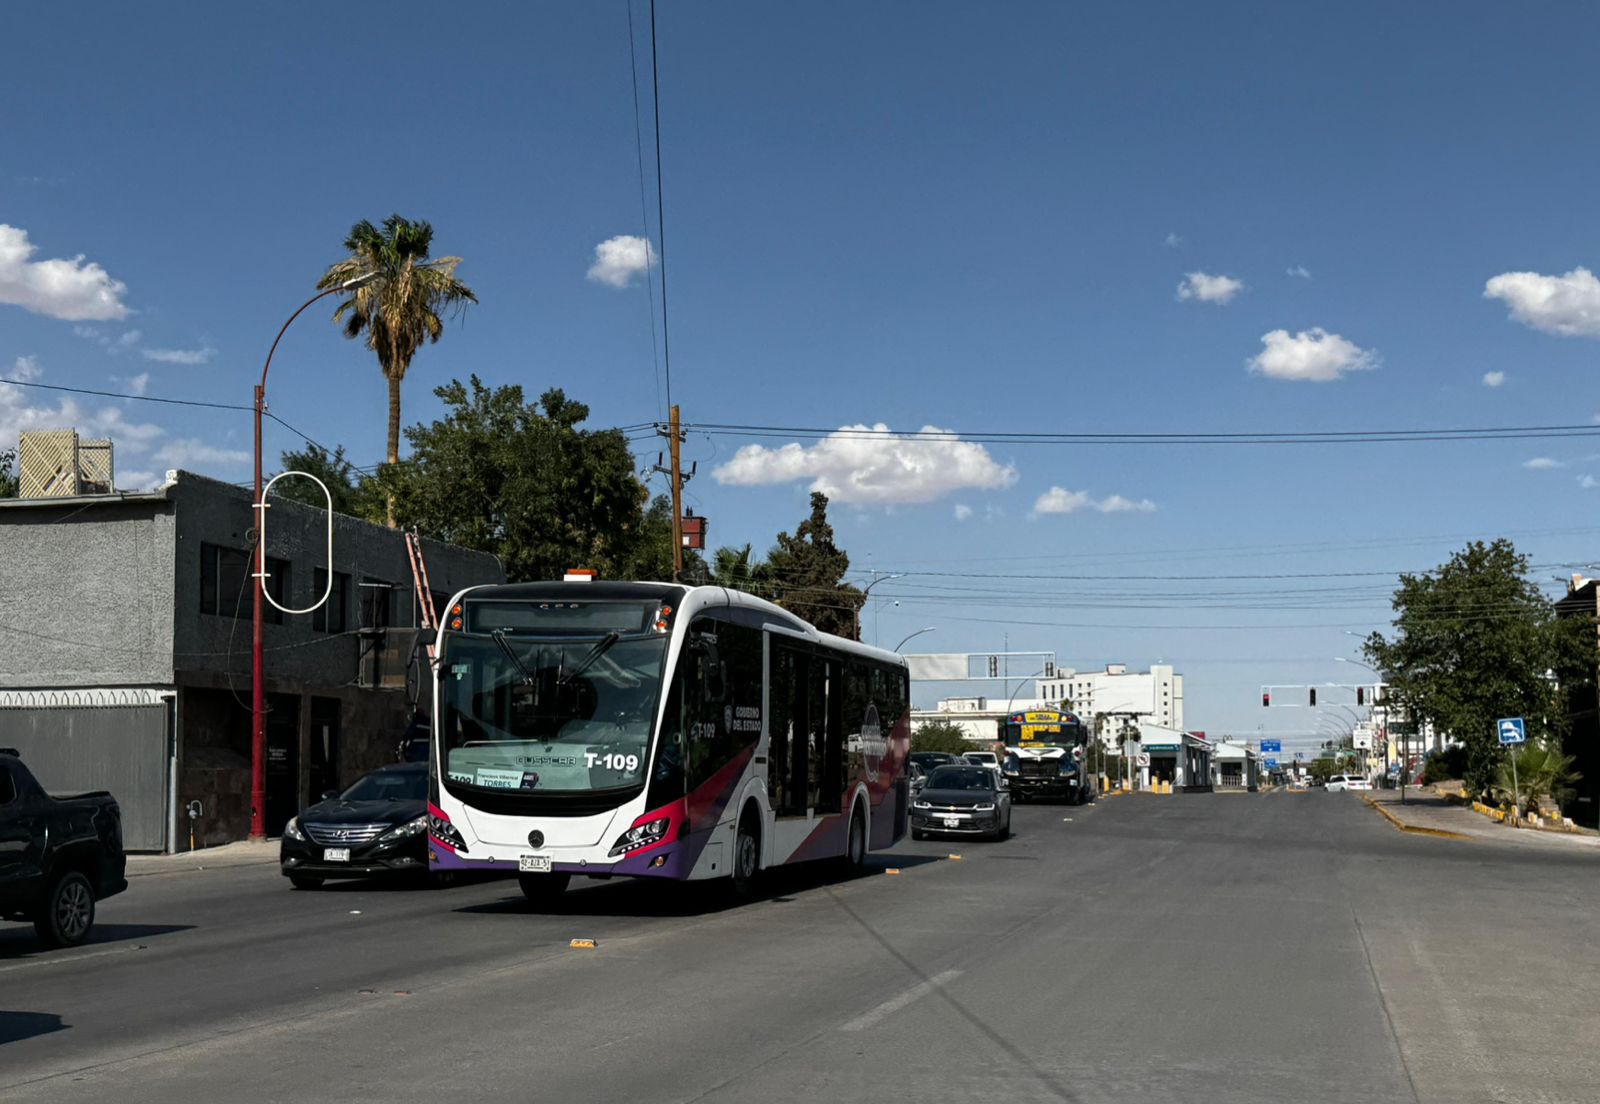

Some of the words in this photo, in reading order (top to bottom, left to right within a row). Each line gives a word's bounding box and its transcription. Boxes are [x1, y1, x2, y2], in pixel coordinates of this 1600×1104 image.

[698, 722, 716, 738] T-109
[584, 753, 638, 771] T-109
[448, 775, 471, 784] 109
[484, 780, 513, 788] TORRES
